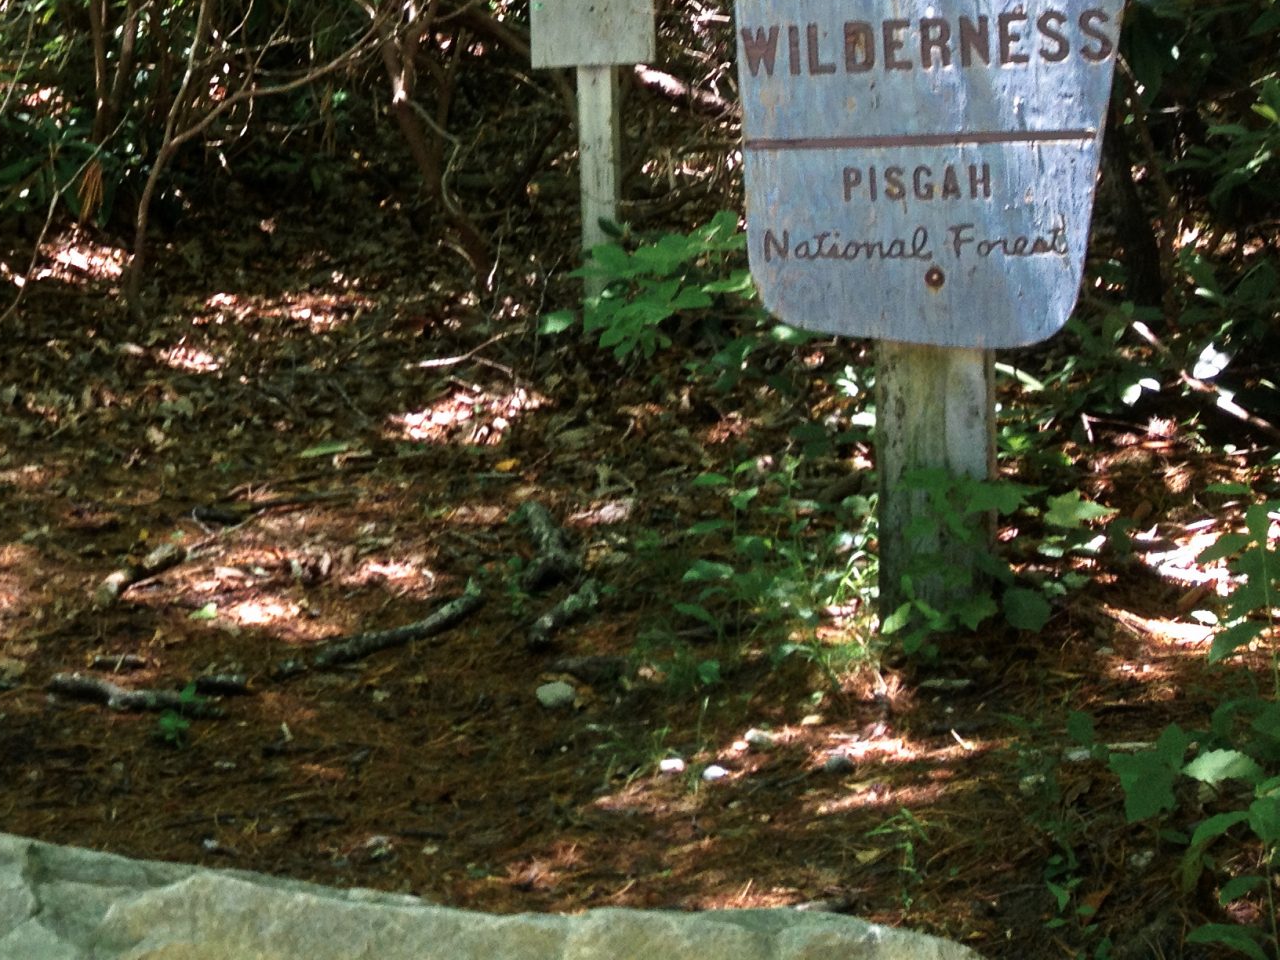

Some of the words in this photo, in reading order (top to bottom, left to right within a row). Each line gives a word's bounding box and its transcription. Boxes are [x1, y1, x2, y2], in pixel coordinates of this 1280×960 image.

[741, 9, 1114, 76] WILDERNESS
[842, 163, 992, 201] PISGAH
[763, 227, 933, 262] National
[947, 222, 1069, 259] Forest
